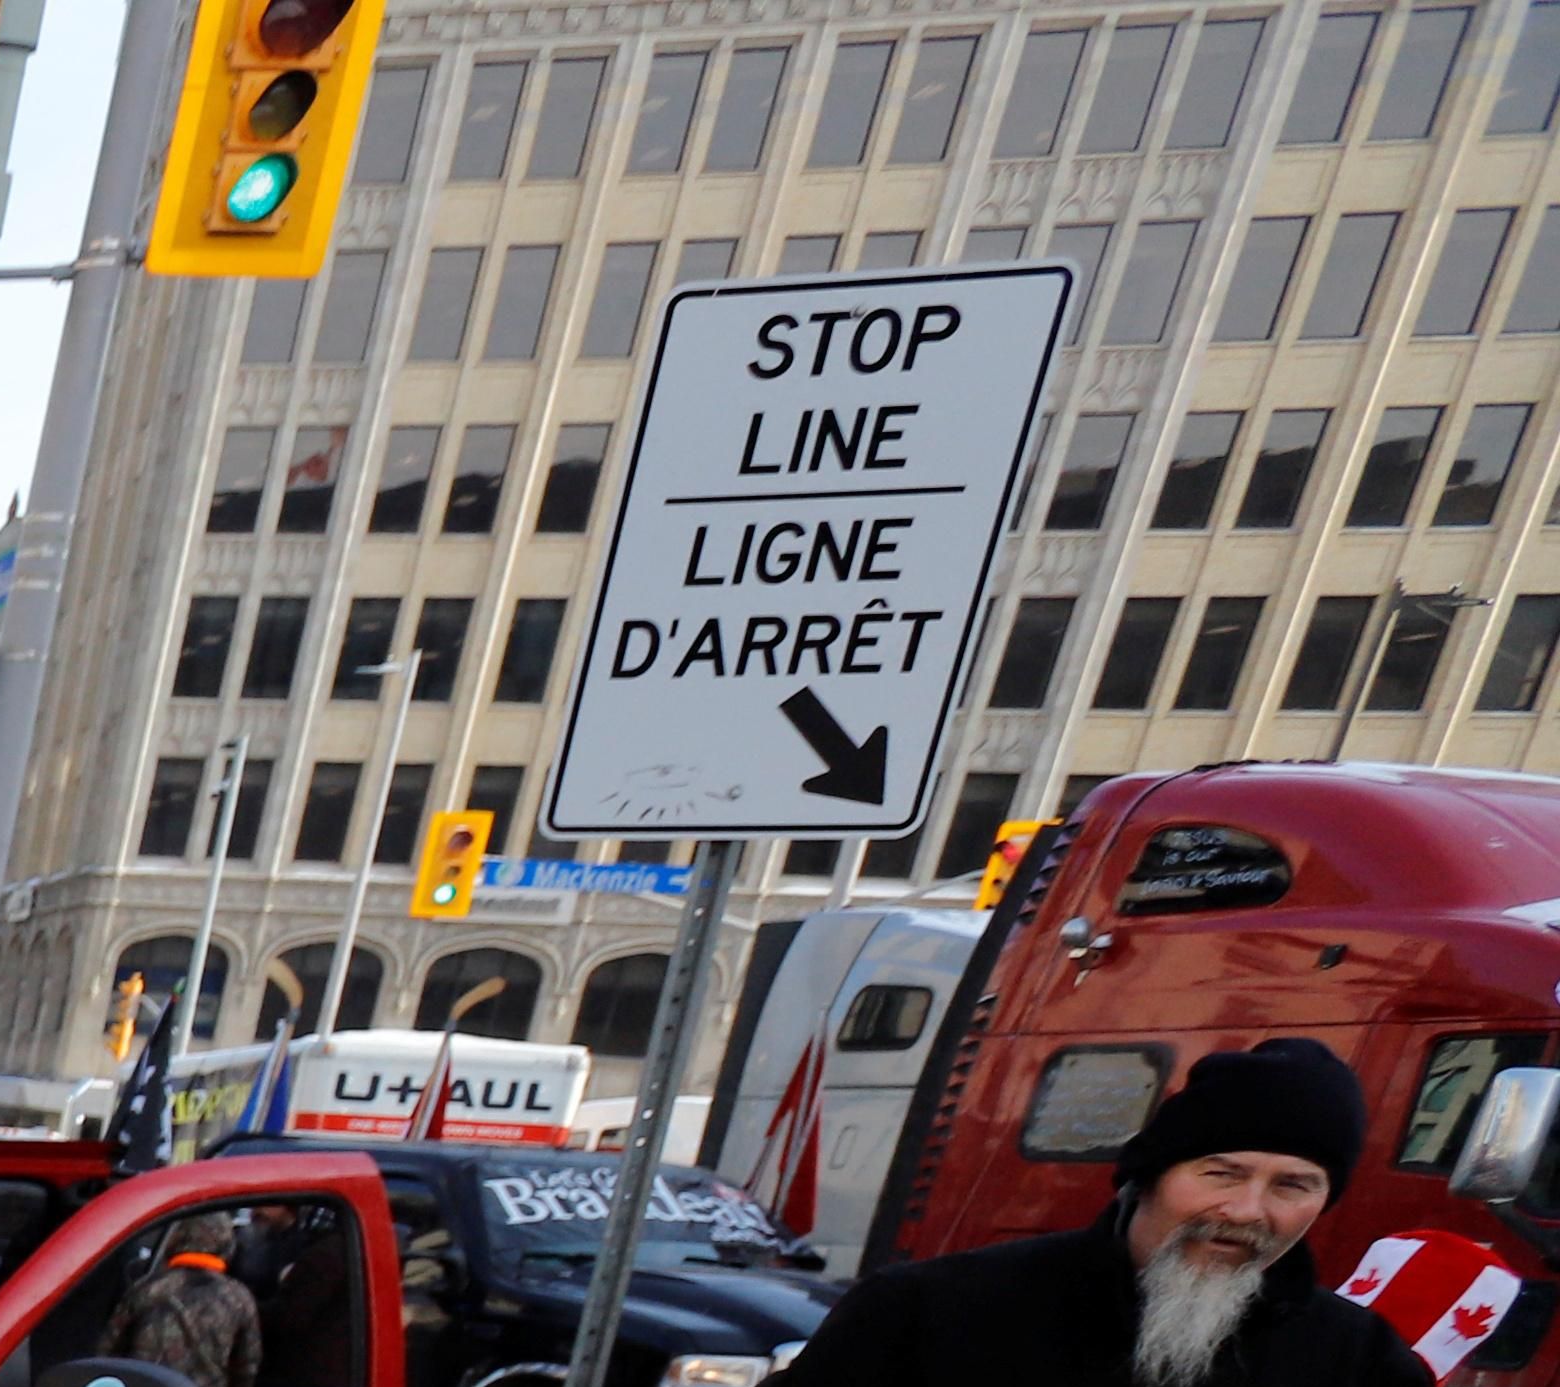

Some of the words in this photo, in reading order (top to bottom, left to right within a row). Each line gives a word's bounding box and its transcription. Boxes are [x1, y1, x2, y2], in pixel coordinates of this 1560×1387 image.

[748, 304, 962, 379] STOP
[738, 404, 920, 475] LINE
[682, 517, 914, 587] LIGNE
[610, 598, 943, 680] D'ARRÊT
[533, 863, 660, 893] Mackenzie
